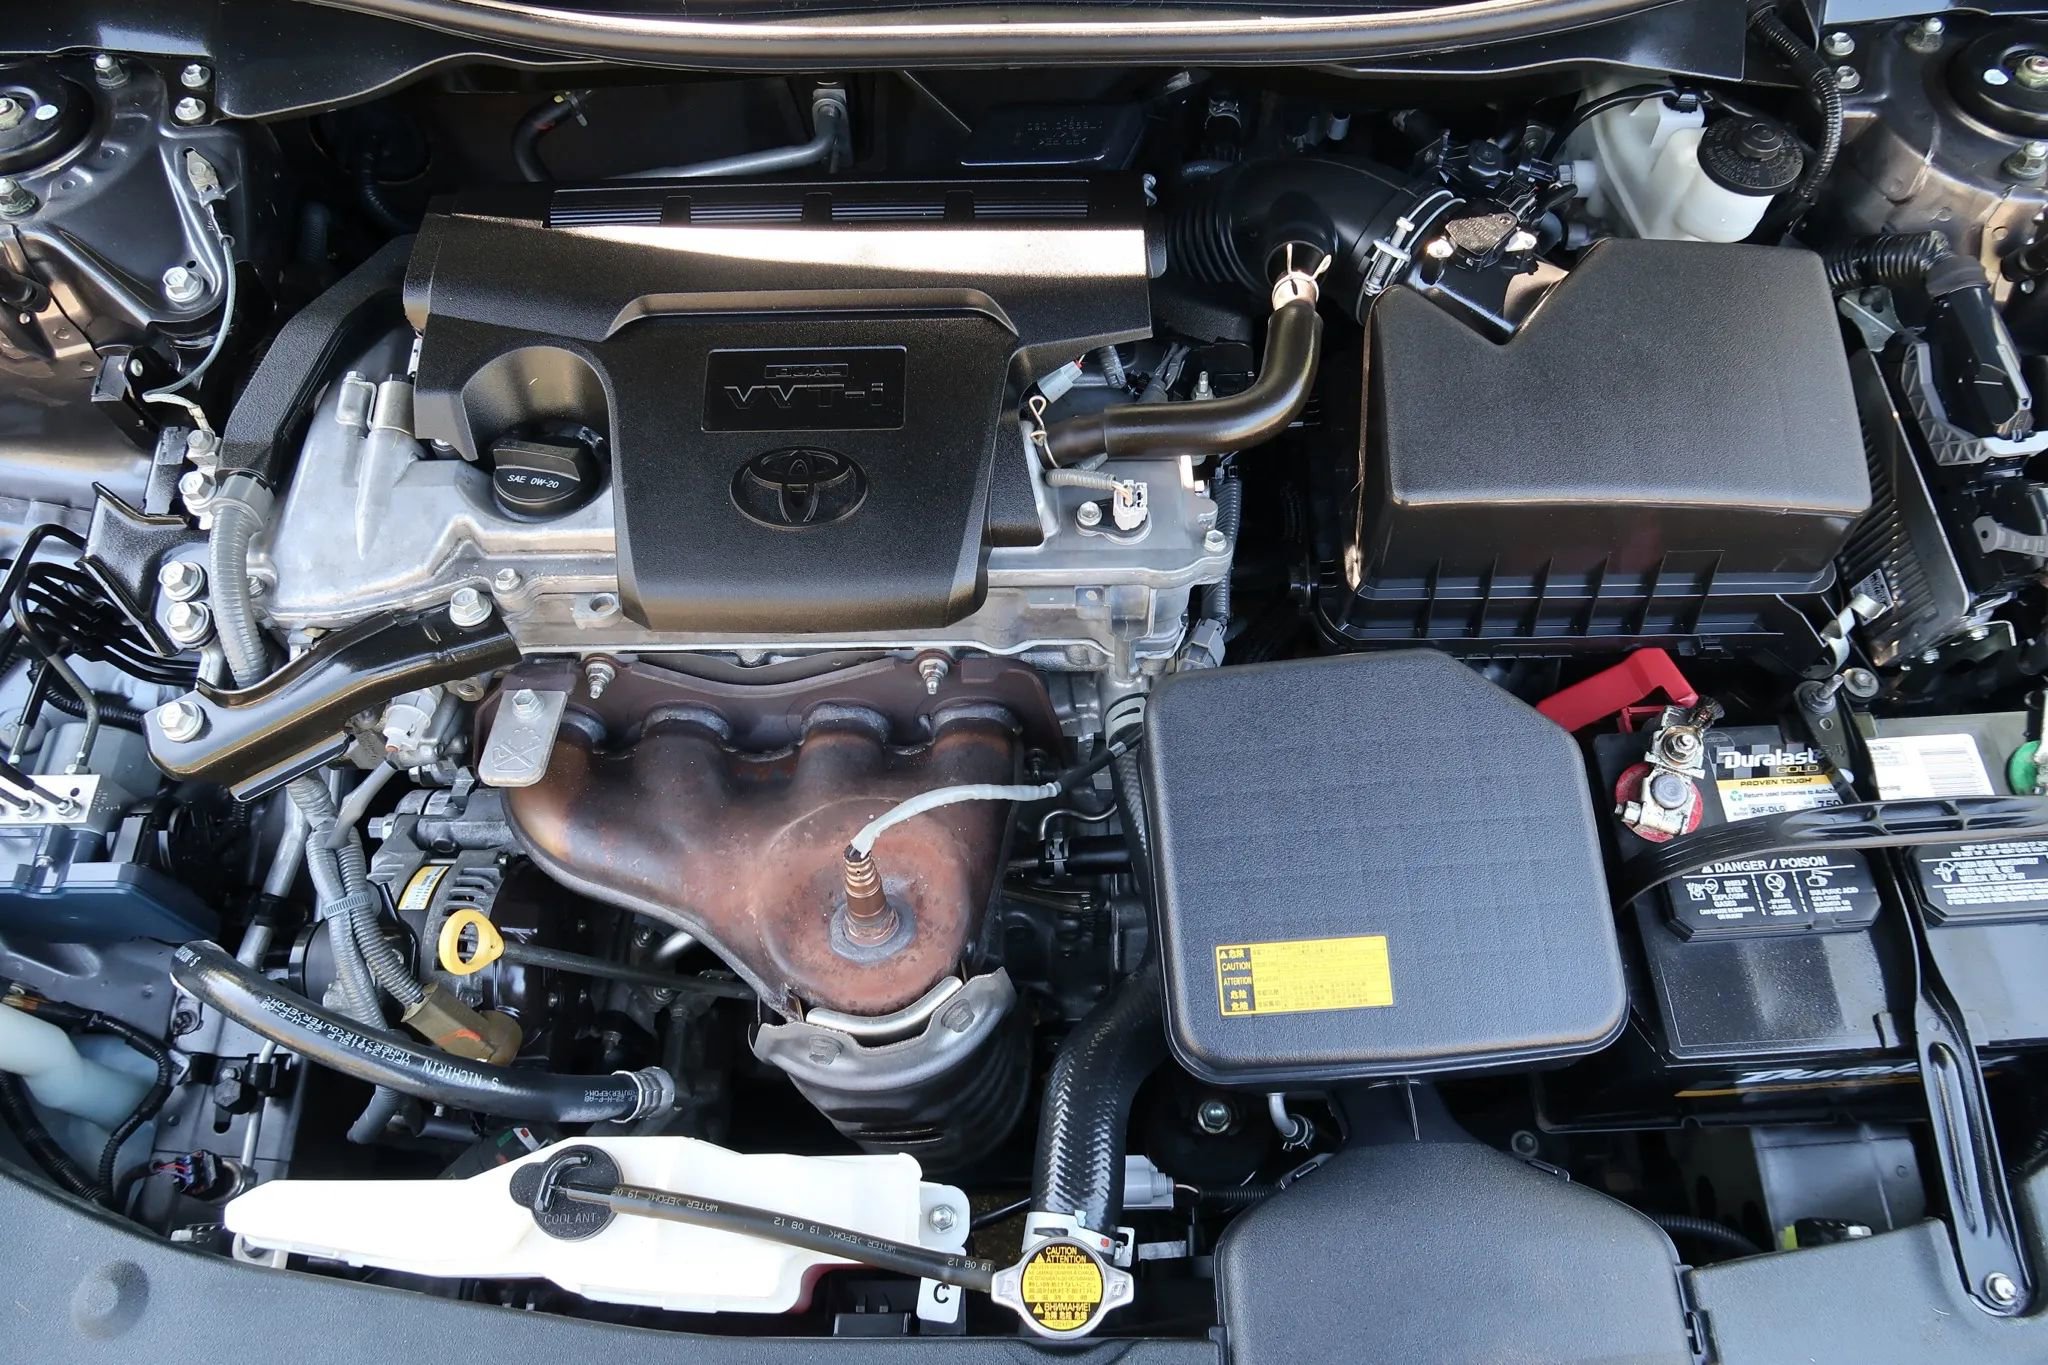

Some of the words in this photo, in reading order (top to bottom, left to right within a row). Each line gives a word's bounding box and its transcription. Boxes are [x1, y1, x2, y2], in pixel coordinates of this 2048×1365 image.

[723, 382, 884, 410] VVT-i
[507, 474, 528, 484] SAE
[530, 477, 560, 489] 0W-20
[1718, 747, 1819, 769] Duralast
[1776, 764, 1819, 774] GOLD
[1740, 779, 1778, 787] PROVEN
[1781, 777, 1812, 785] TOUGH
[1750, 805, 1786, 814] 24F-DLG
[1714, 860, 1768, 873] DANGER
[1779, 856, 1829, 868] POISON
[1221, 961, 1251, 971] CAUTION
[1223, 976, 1252, 986] ATTENTION
[421, 1059, 482, 1087] NICHIRIN
[627, 1189, 639, 1199] 19
[686, 1200, 719, 1213] WATER
[544, 1213, 597, 1225] COOLANT
[773, 1216, 785, 1227] 12
[791, 1220, 804, 1231] 08
[809, 1225, 820, 1236] 19
[867, 1239, 897, 1255] WATER
[1046, 1246, 1077, 1255] CAUTION
[947, 1257, 959, 1267] 12
[964, 1259, 977, 1269] 08
[1046, 1255, 1087, 1263] ATTENTION
[981, 1262, 991, 1272] 19
[933, 1282, 950, 1304] C
[1044, 1303, 1091, 1312] ВНИМАНИЕ!
